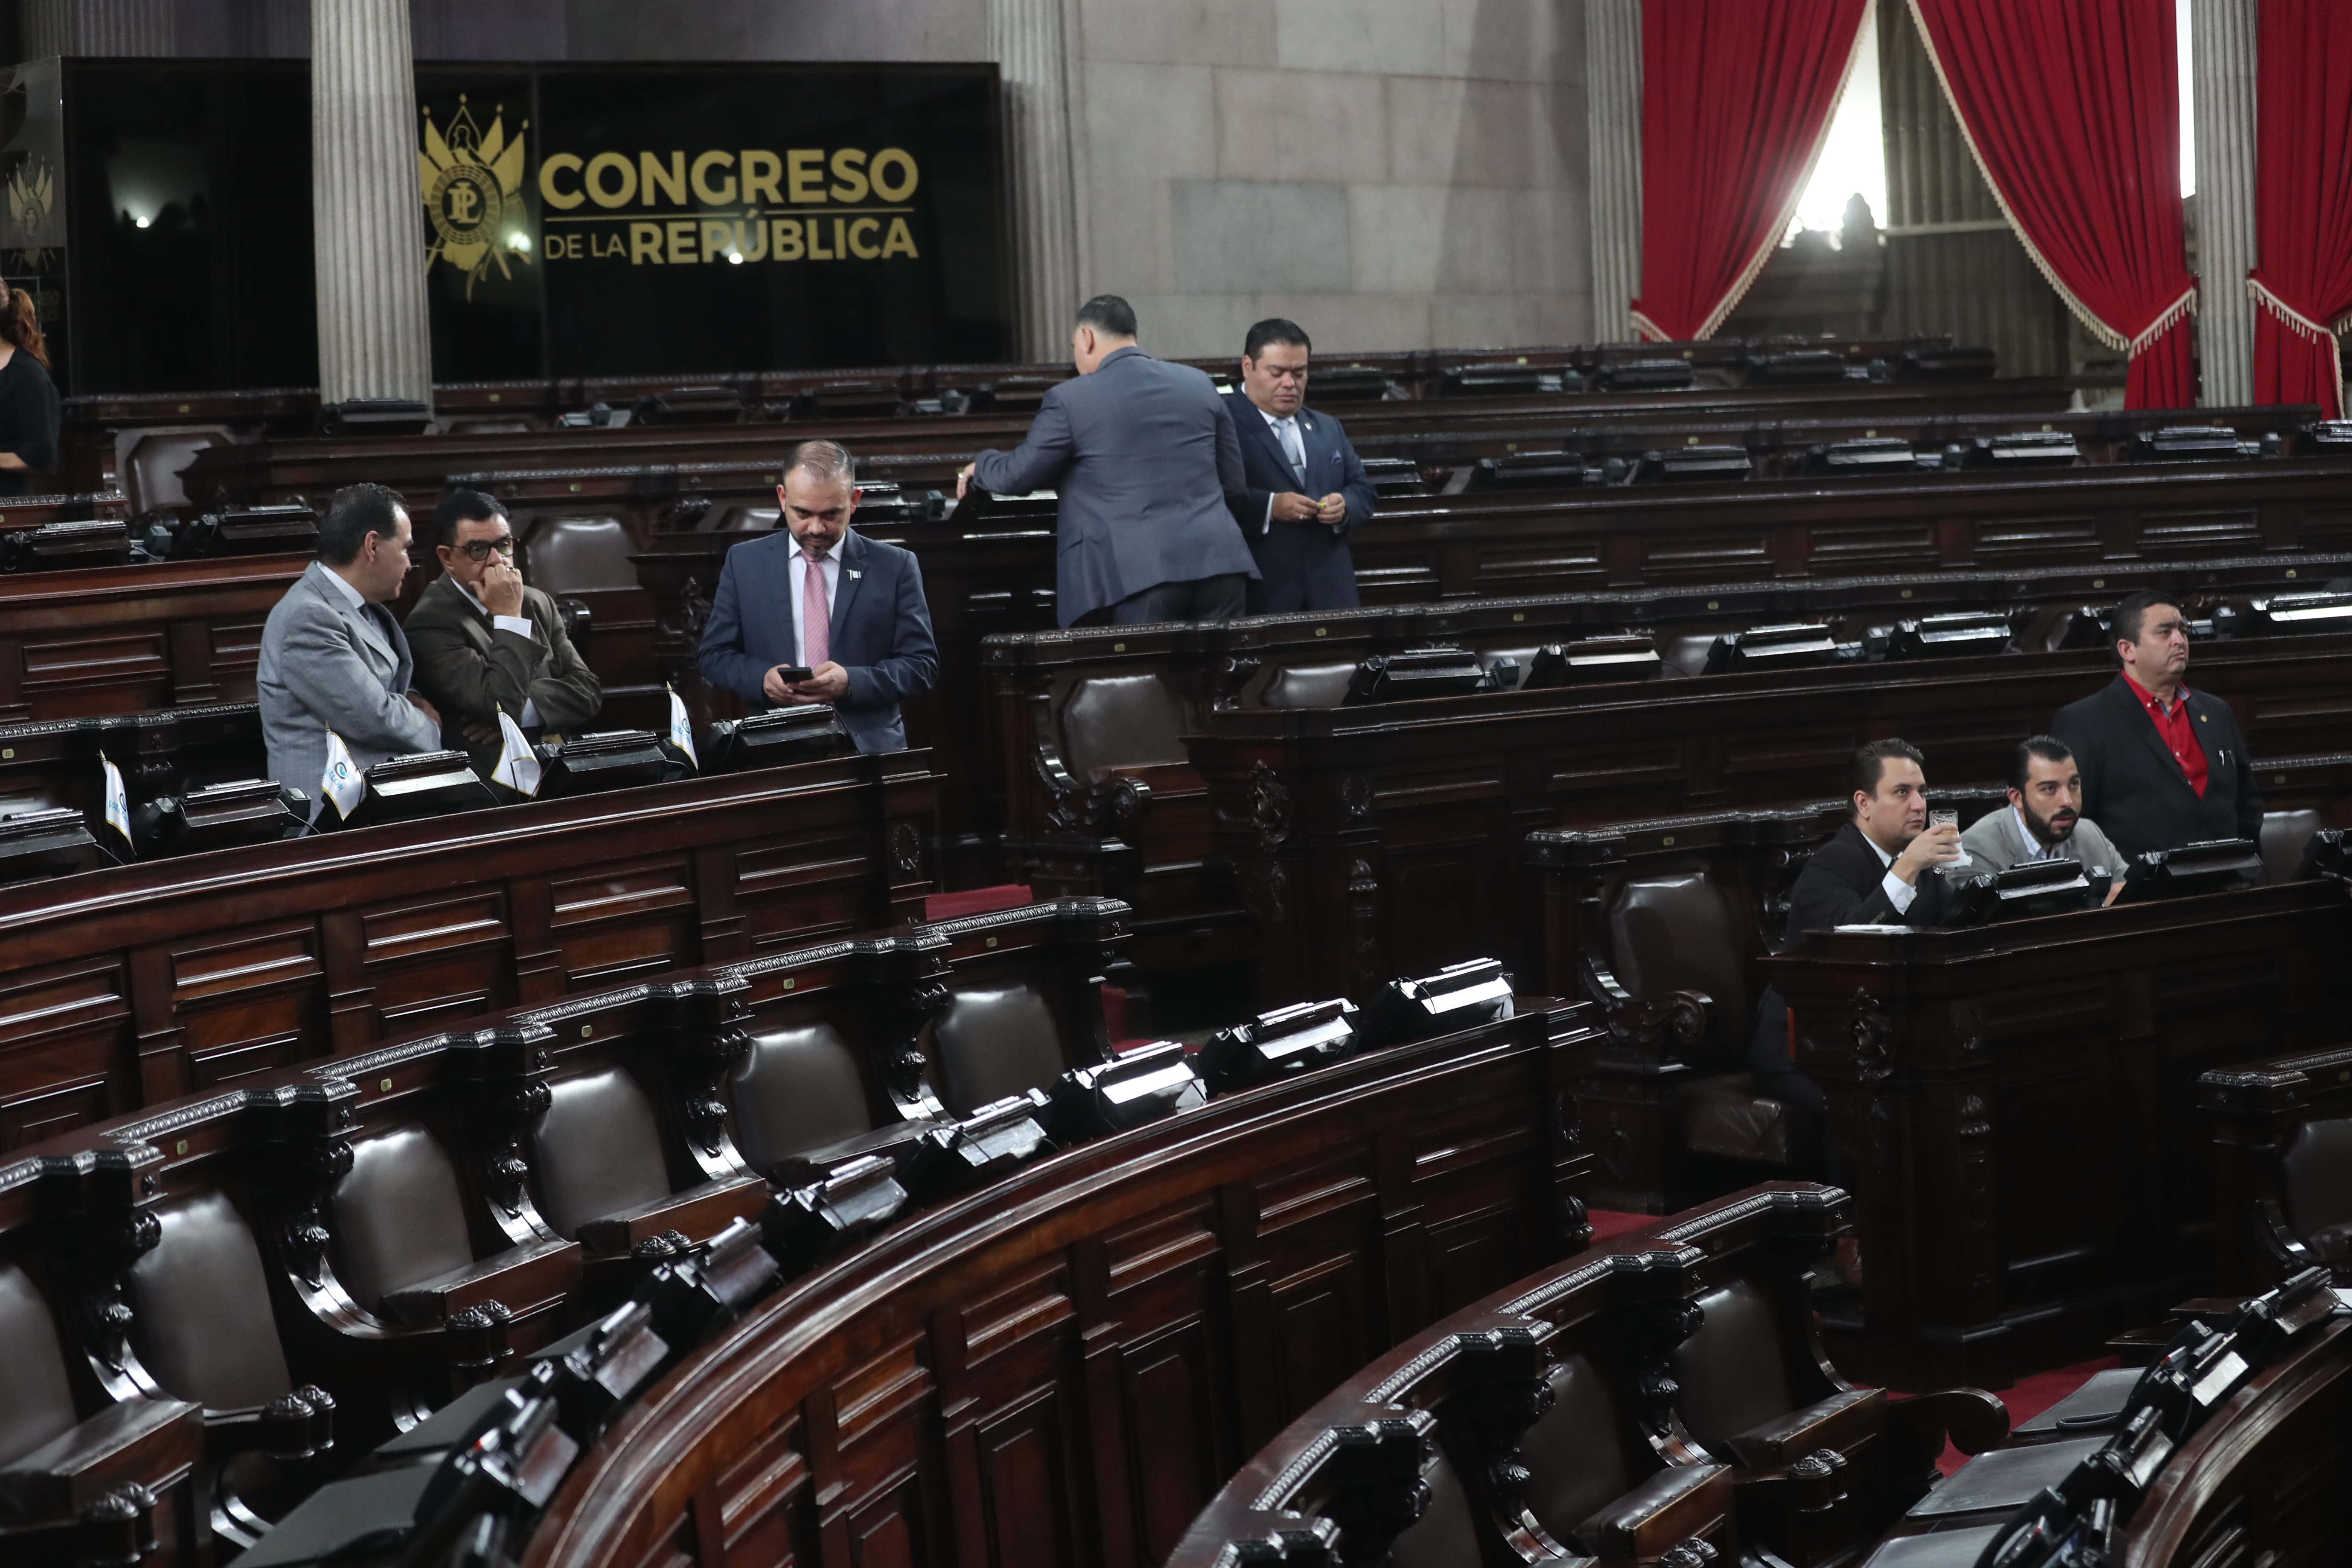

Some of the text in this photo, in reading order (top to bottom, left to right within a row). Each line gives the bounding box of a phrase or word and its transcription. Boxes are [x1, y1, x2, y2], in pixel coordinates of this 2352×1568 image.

[539, 147, 919, 209] CONGRESO
[545, 208, 919, 265] DE LA REPÚBLICA
[325, 769, 343, 791] VALOR
